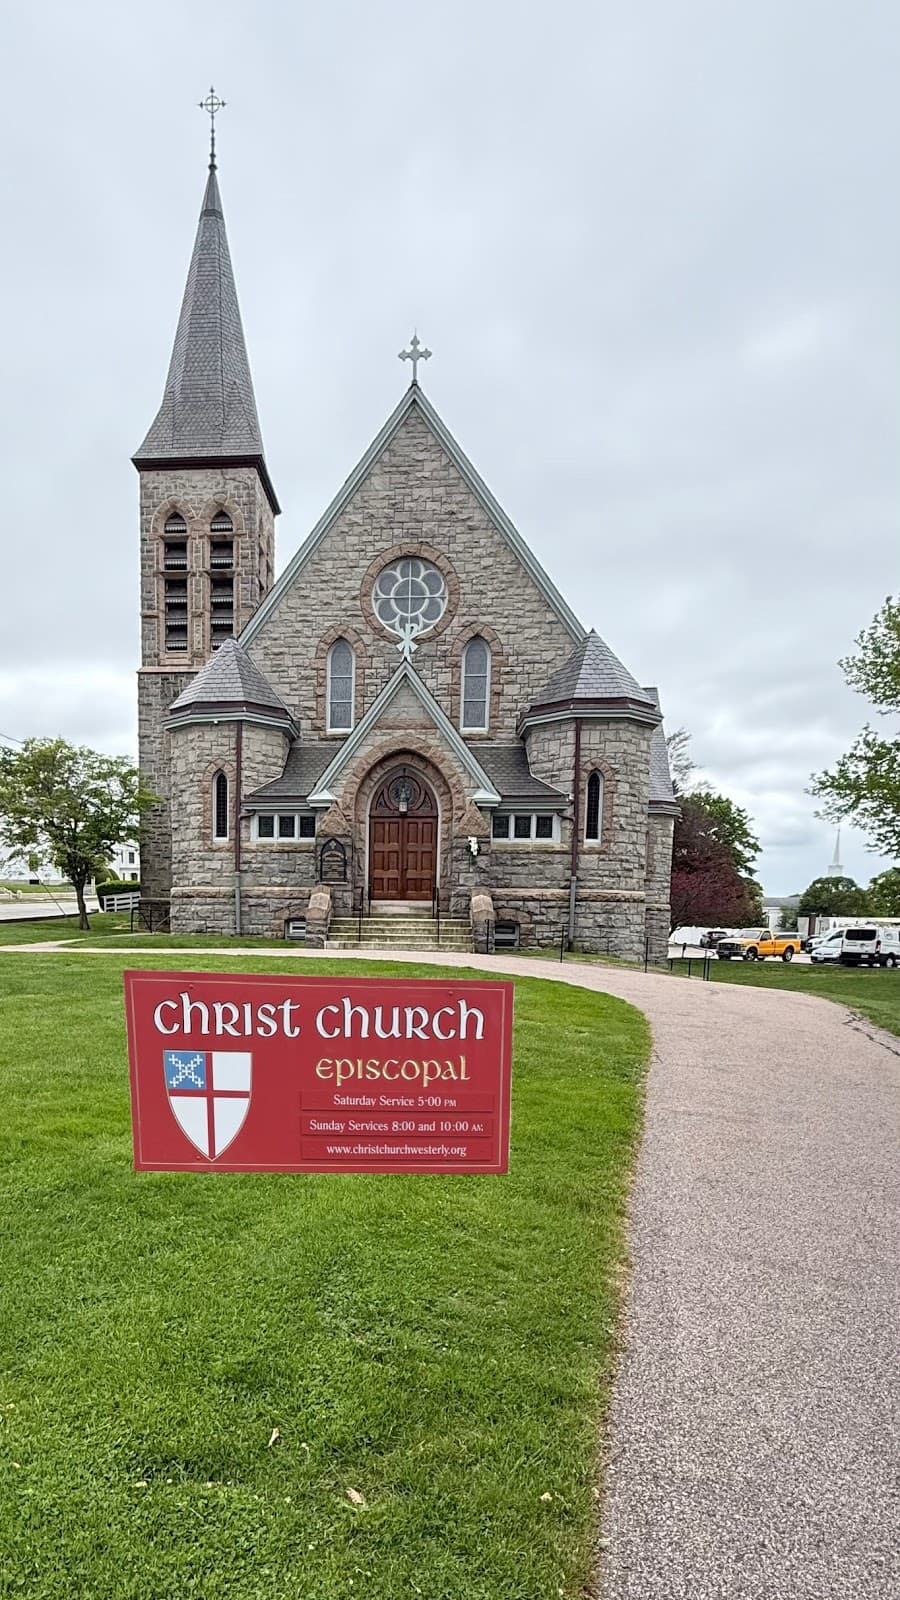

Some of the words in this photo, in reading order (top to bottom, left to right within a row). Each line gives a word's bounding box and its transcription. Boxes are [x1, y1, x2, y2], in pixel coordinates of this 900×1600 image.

[333, 1093, 377, 1107] Saturday
[379, 1095, 415, 1107] Service
[443, 1099, 457, 1107] PM
[309, 1119, 346, 1134] Sunday
[348, 1120, 389, 1131] Services
[391, 1121, 416, 1132] 8:00
[417, 1121, 436, 1132] and
[440, 1121, 469, 1132] 10:00
[326, 1143, 467, 1158] www.christchurchwesterly.org
